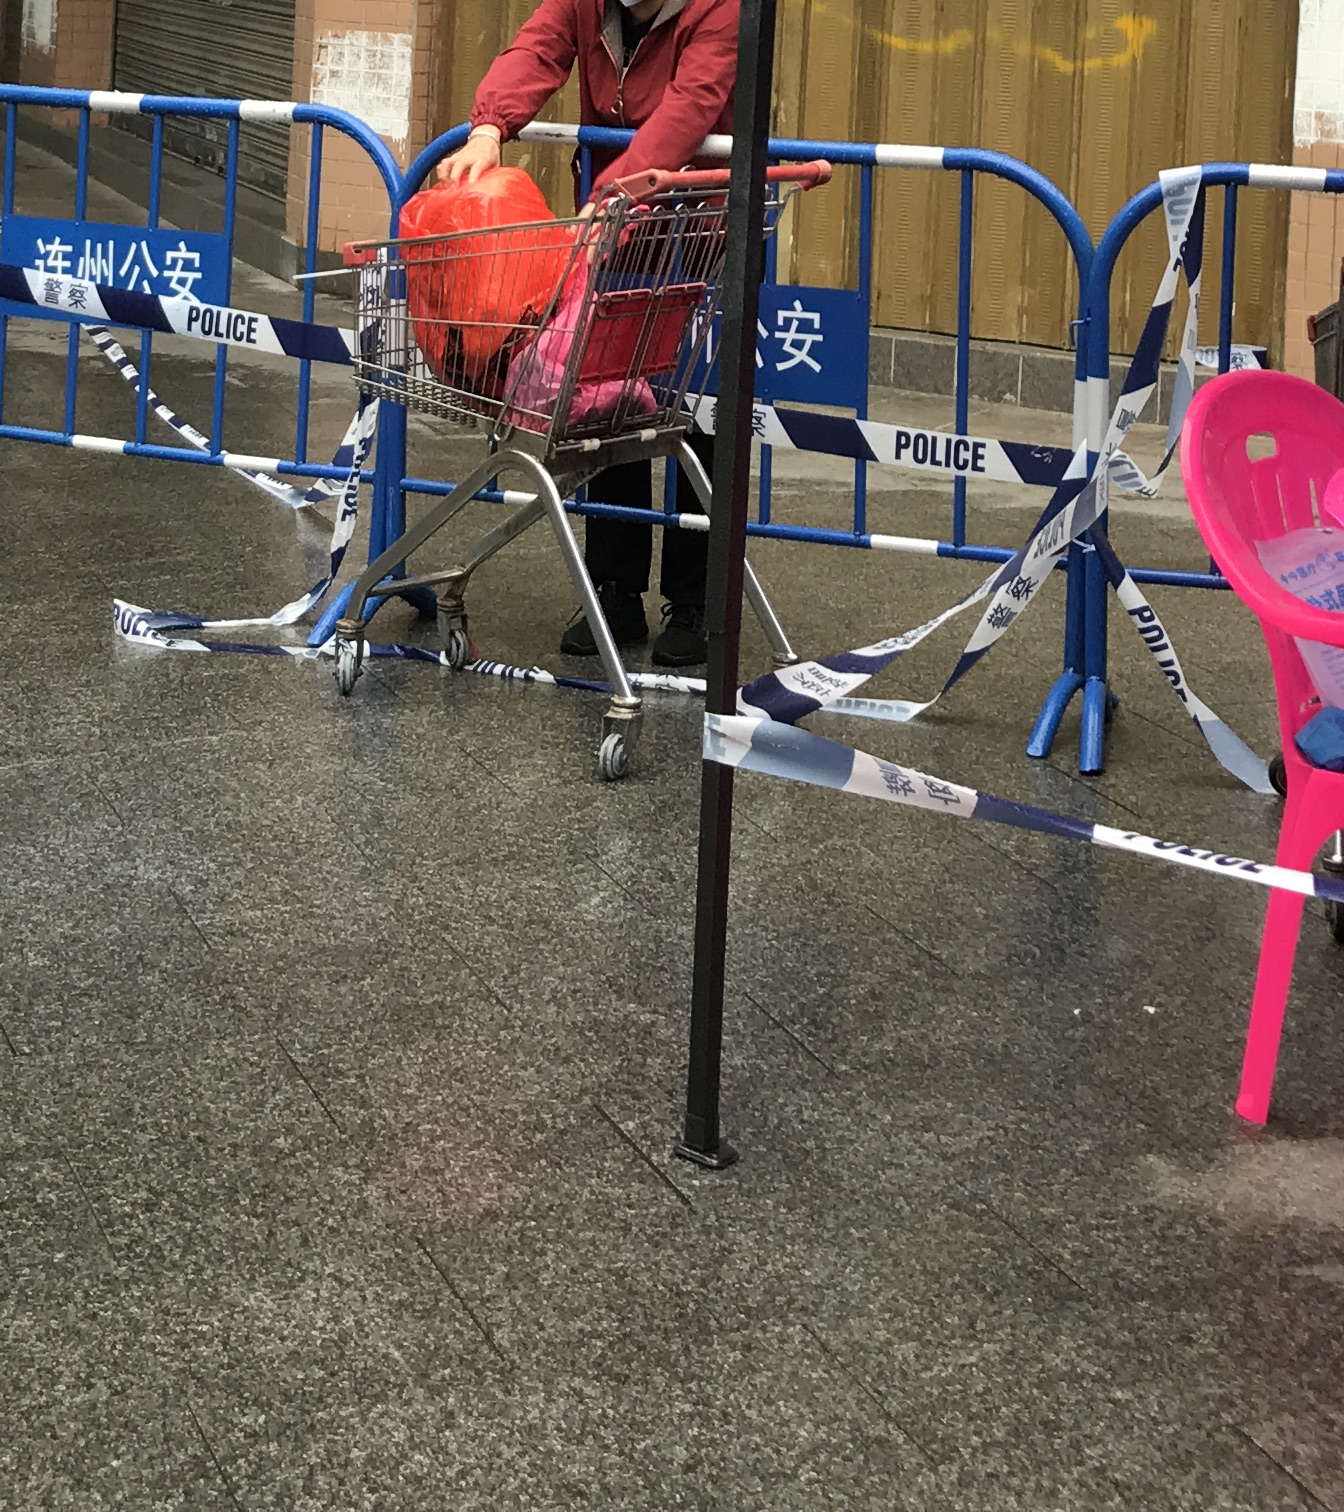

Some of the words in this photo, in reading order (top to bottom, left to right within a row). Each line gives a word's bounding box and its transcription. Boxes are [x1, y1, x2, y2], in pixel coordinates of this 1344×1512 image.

[34, 235, 204, 305] 连州公安
[43, 276, 88, 310] 警察
[186, 304, 260, 345] POLICE
[894, 429, 988, 474] POLICE
